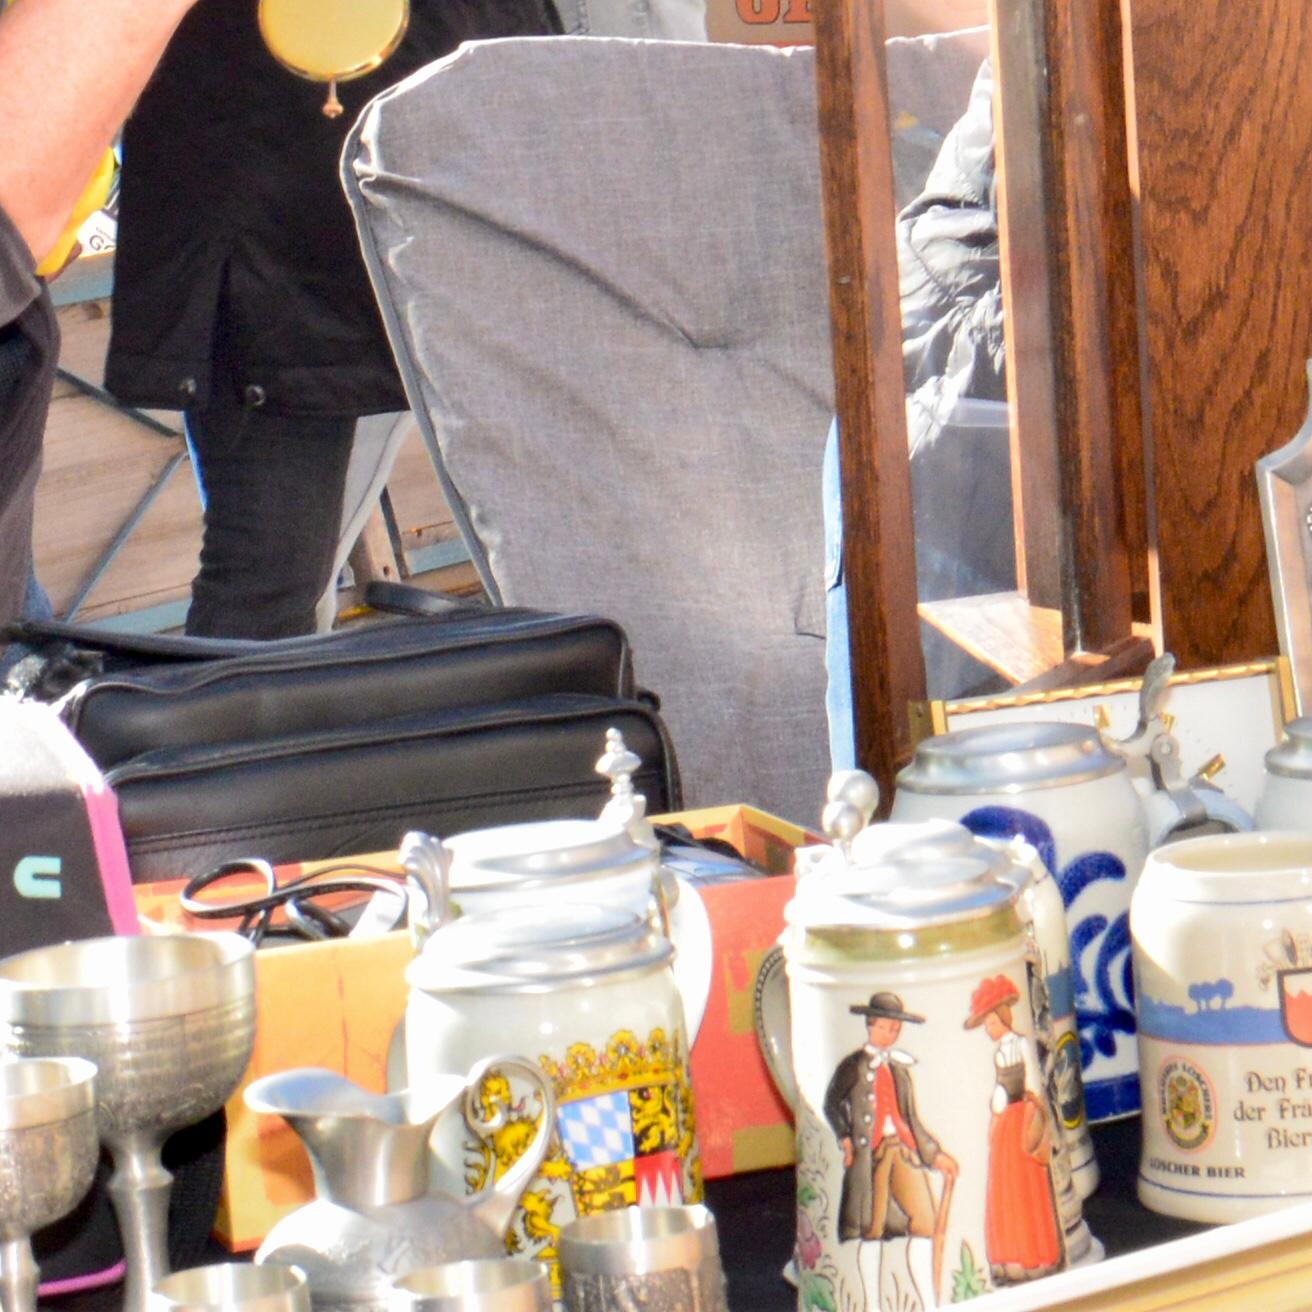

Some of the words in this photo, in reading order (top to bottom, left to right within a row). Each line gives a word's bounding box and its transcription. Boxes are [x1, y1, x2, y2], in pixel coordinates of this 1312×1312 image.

[1246, 1070, 1287, 1094] Den
[1233, 1100, 1267, 1122] der
[1206, 1166, 1246, 1179] BIER
